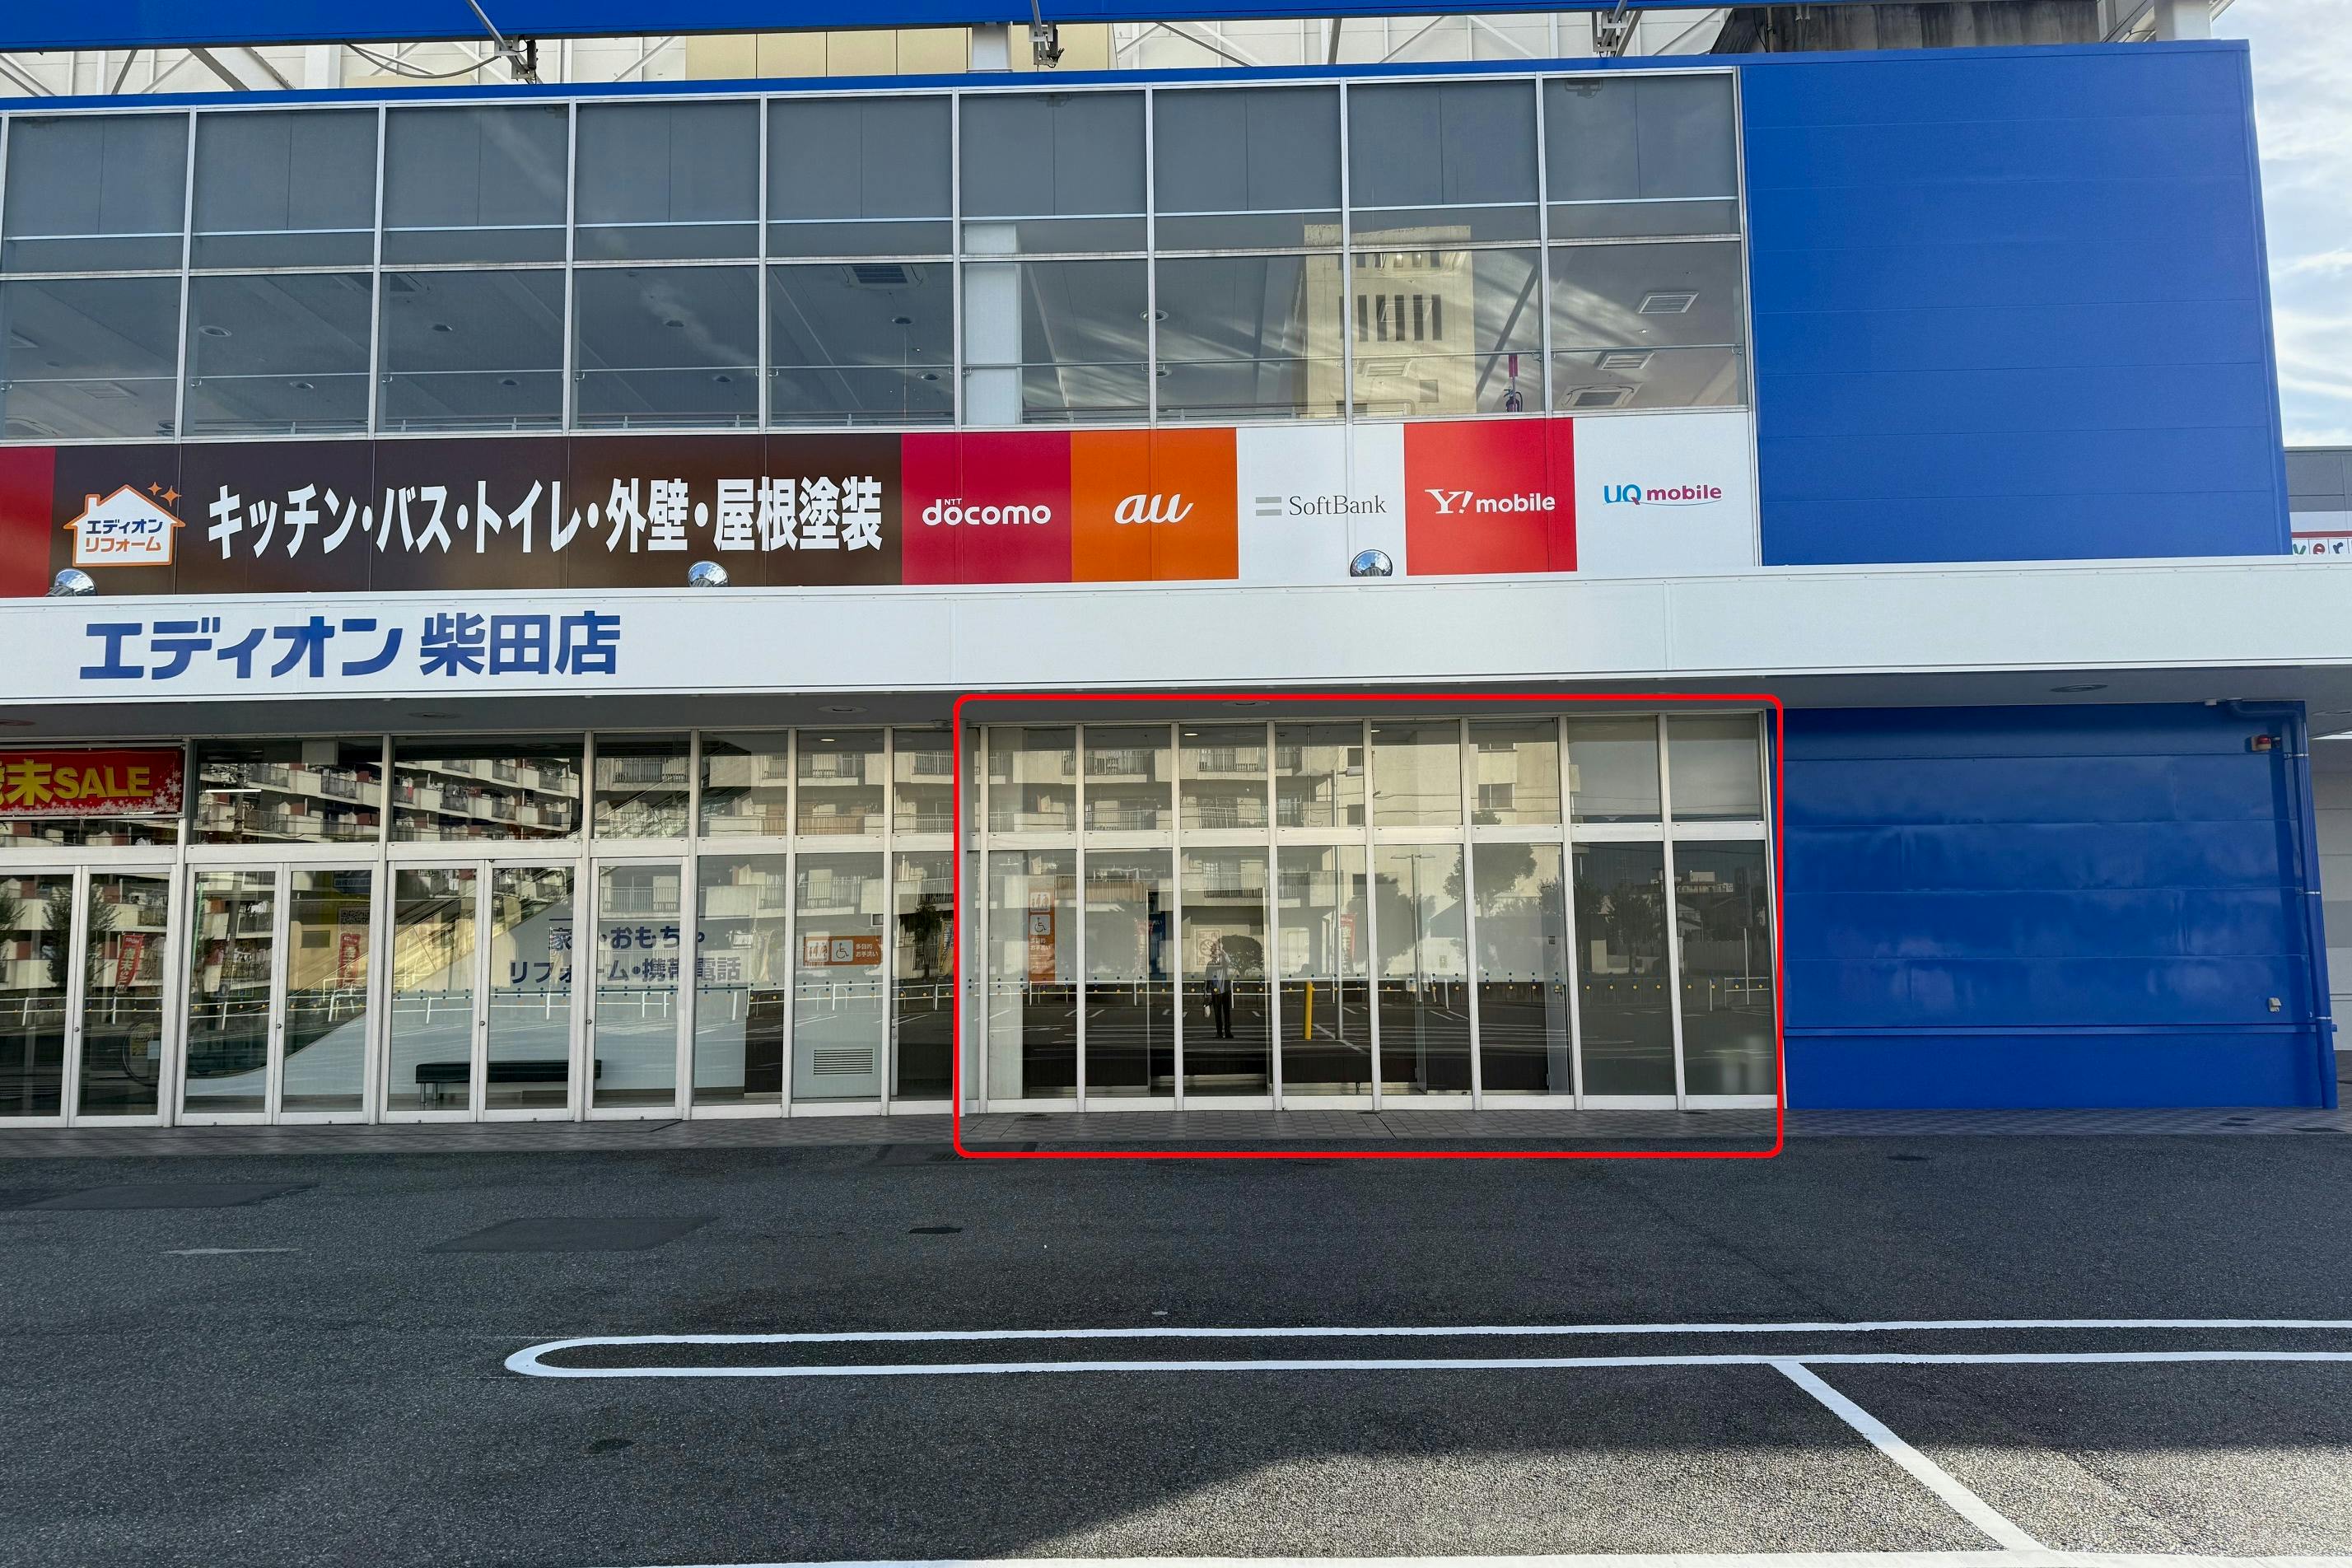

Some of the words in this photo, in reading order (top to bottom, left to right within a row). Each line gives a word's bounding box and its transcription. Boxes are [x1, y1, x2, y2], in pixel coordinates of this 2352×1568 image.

[944, 497, 963, 506] NTT
[1288, 494, 1388, 516] SoftBank
[1603, 483, 1641, 505] UQ
[1647, 484, 1722, 501] mobile
[208, 475, 883, 560] キッチン・バス・トイレ・外壁・屋根塗装
[922, 498, 1052, 526] docomo
[1114, 493, 1193, 524] au
[86, 519, 163, 534] エディオン
[86, 535, 161, 553] リフォーム
[2293, 542, 2352, 555] ver
[0, 758, 154, 806] 末SALE
